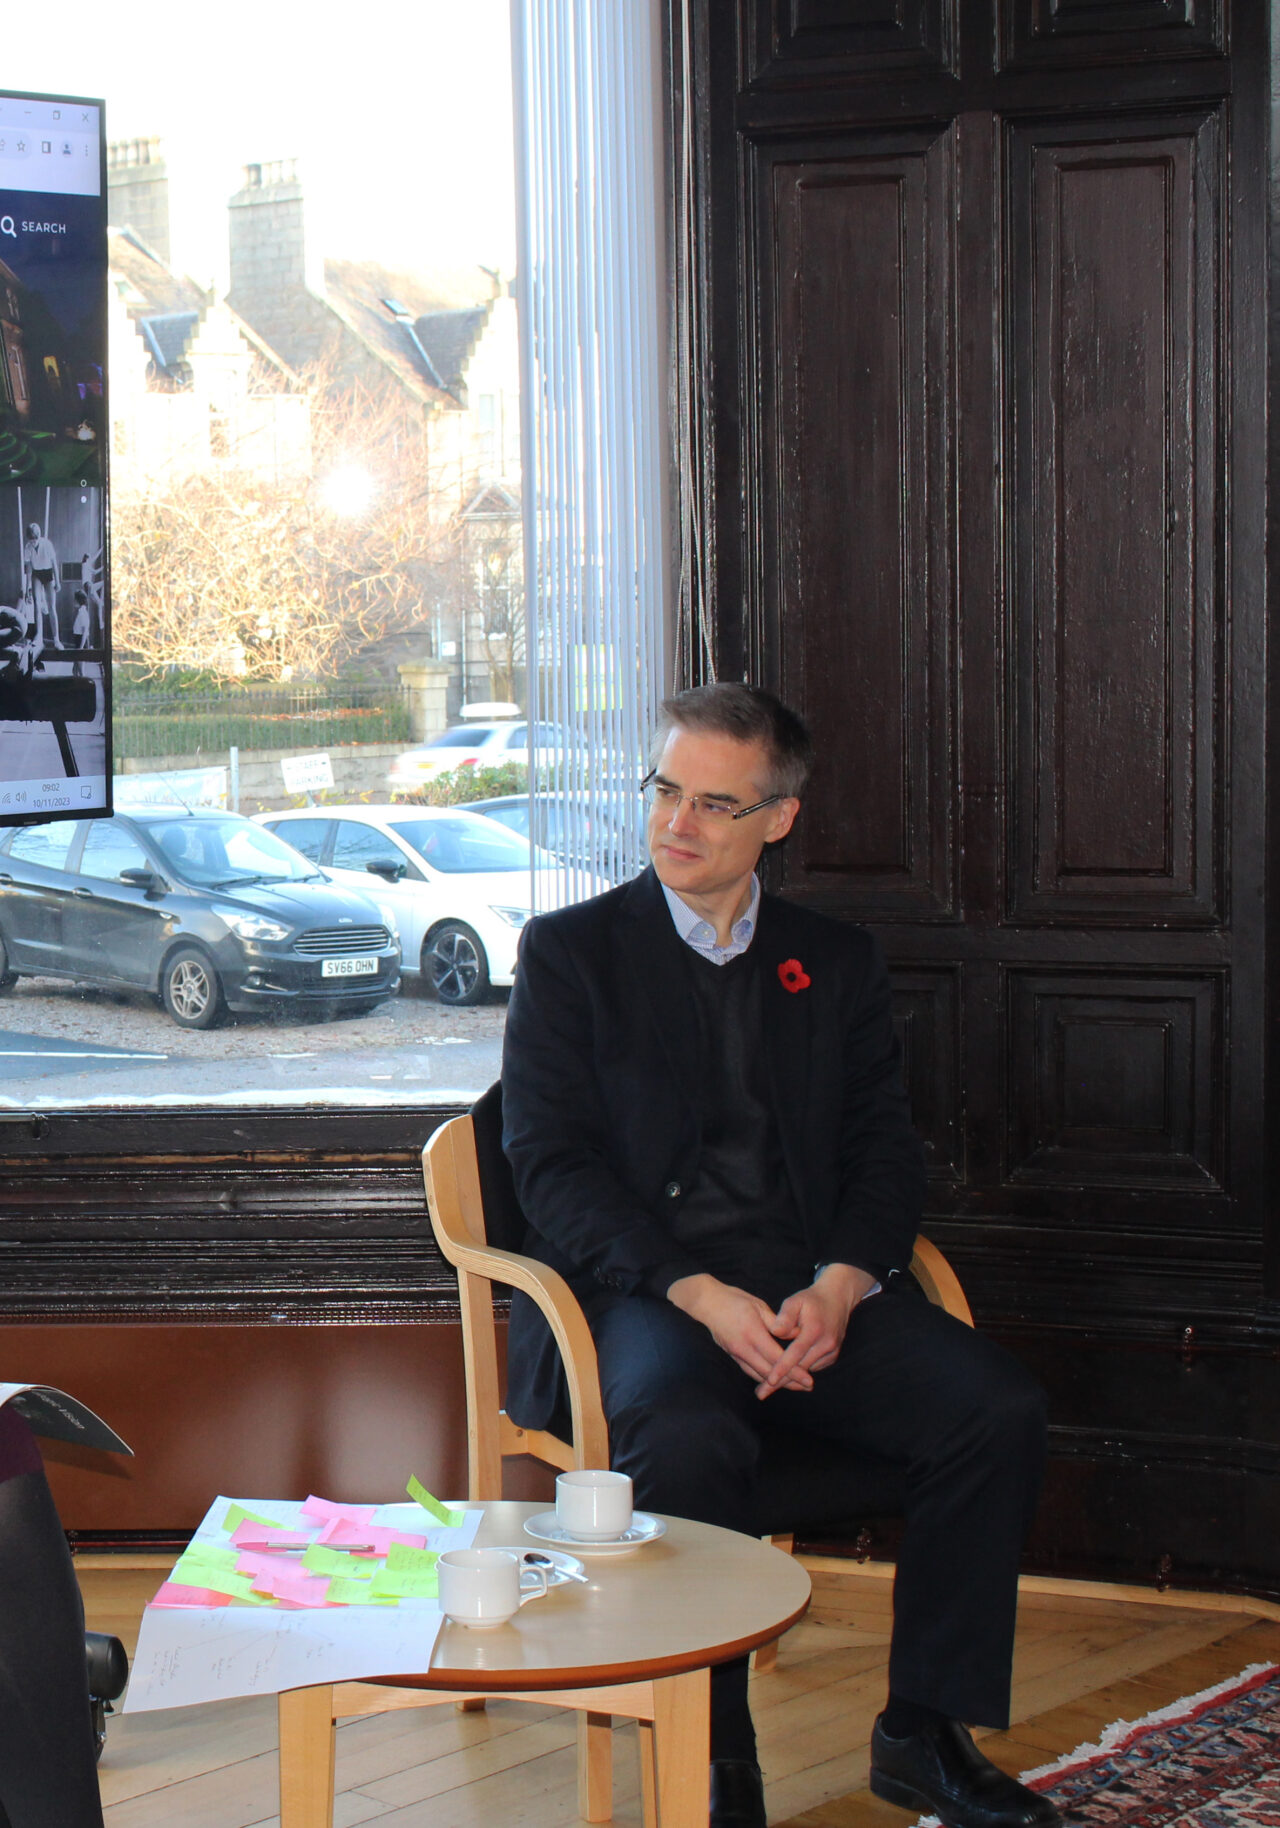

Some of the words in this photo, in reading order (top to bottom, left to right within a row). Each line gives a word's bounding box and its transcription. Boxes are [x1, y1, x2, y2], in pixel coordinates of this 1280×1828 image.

[21, 220, 67, 235] SEARCH
[41, 782, 61, 793] 09:02
[32, 796, 71, 809] 10/11/2023
